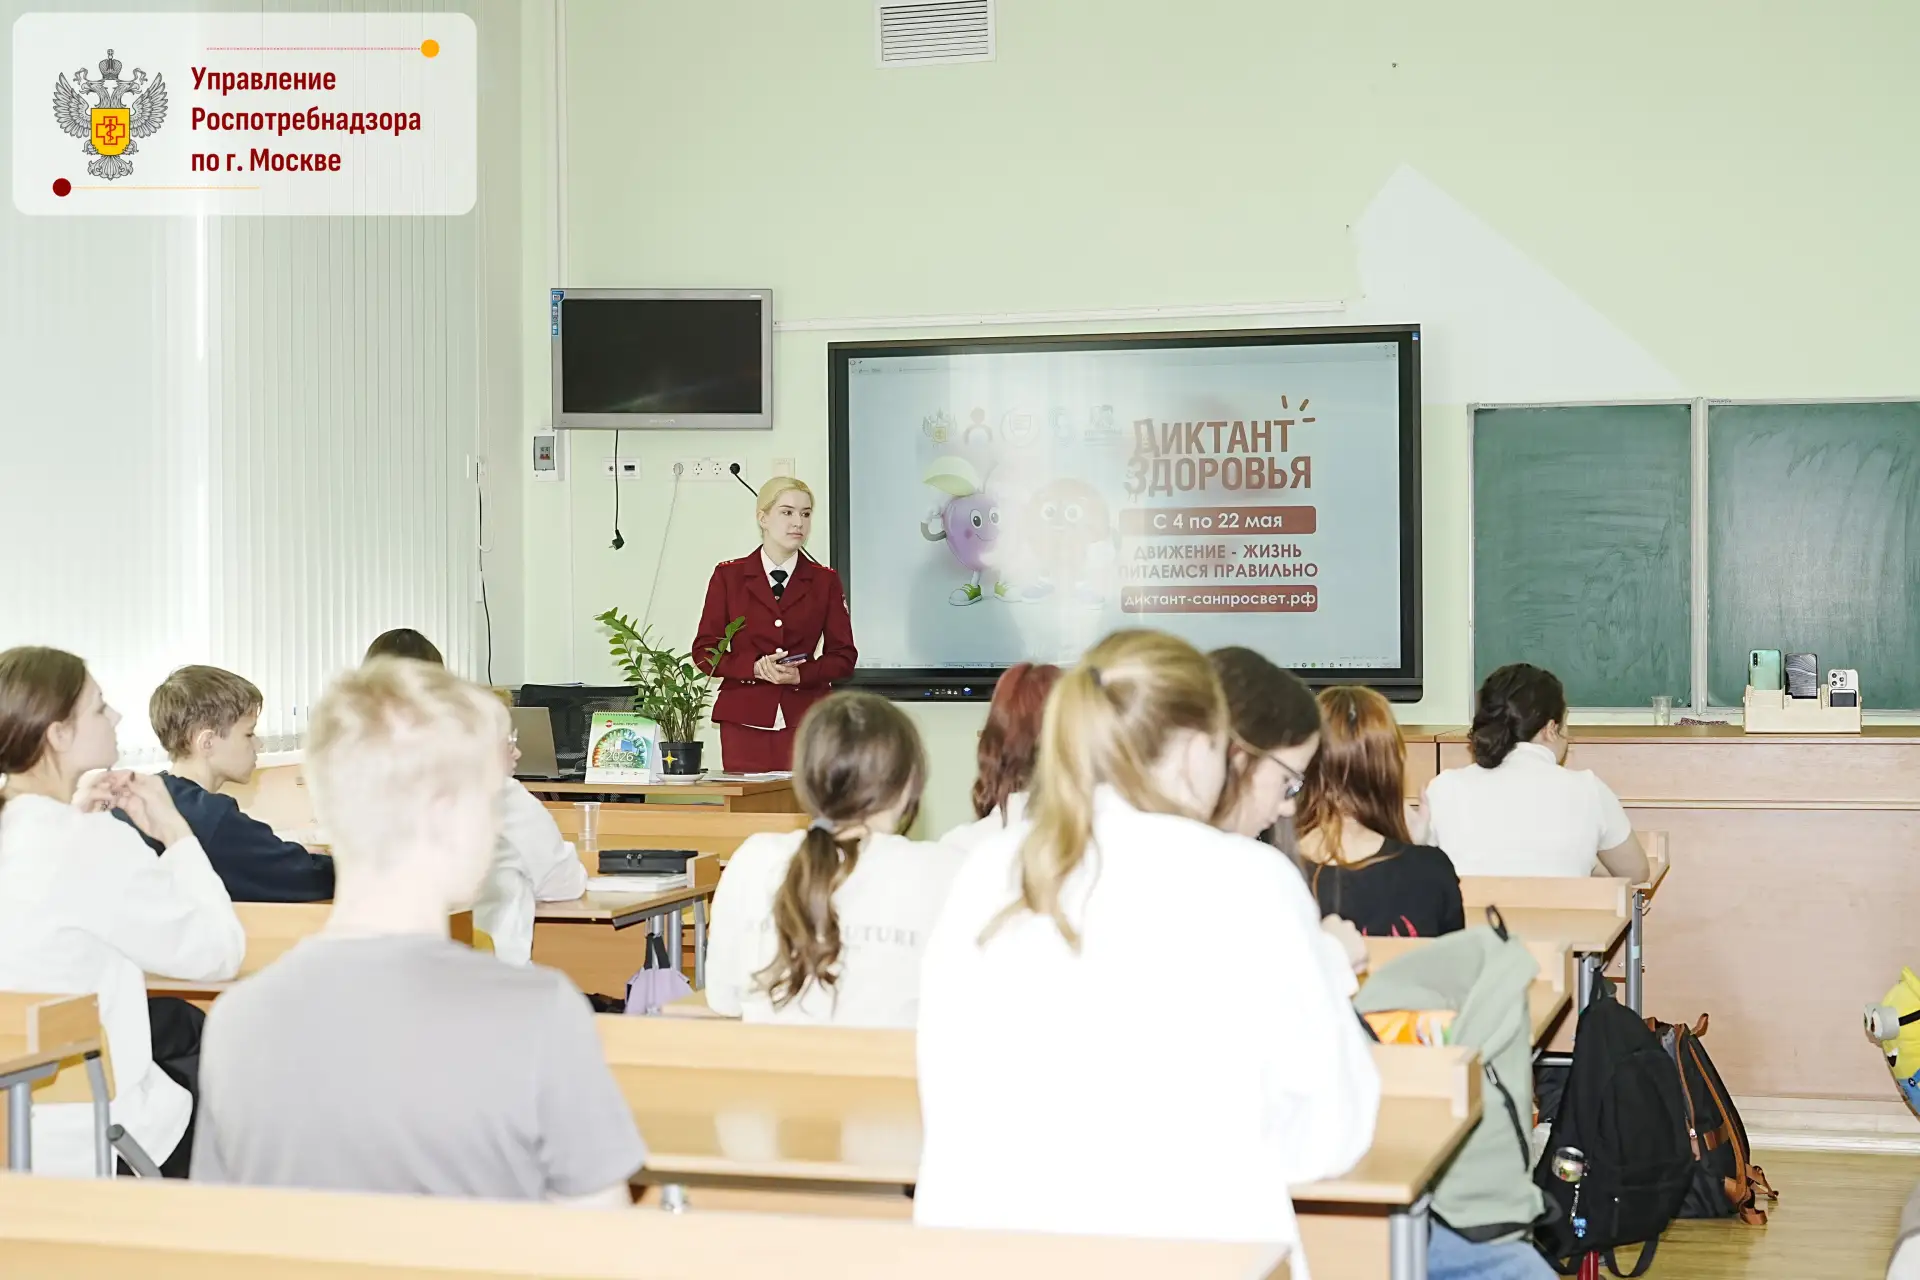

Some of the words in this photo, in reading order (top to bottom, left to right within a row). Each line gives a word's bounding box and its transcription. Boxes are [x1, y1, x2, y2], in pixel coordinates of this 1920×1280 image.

[1134, 418, 1295, 457] ДИКТАНТ
[1124, 456, 1312, 499] ЗДОРОВЬЯ
[1153, 514, 1167, 529] С
[1172, 514, 1184, 529] 4
[1189, 517, 1213, 529] по
[1218, 513, 1240, 529] 22
[1244, 515, 1283, 528] мая
[1133, 545, 1226, 560] ДВИЖЕНИЕ
[1243, 544, 1302, 559] ЖИЗНЬ
[1119, 564, 1208, 579] ПИТАЕМСЯ
[1214, 563, 1318, 578] ПРАВИЛЬНО
[1124, 592, 1316, 608] диктант-санпросвет.рф
[606, 751, 634, 762] 2026
[844, 924, 920, 947] UTURE
